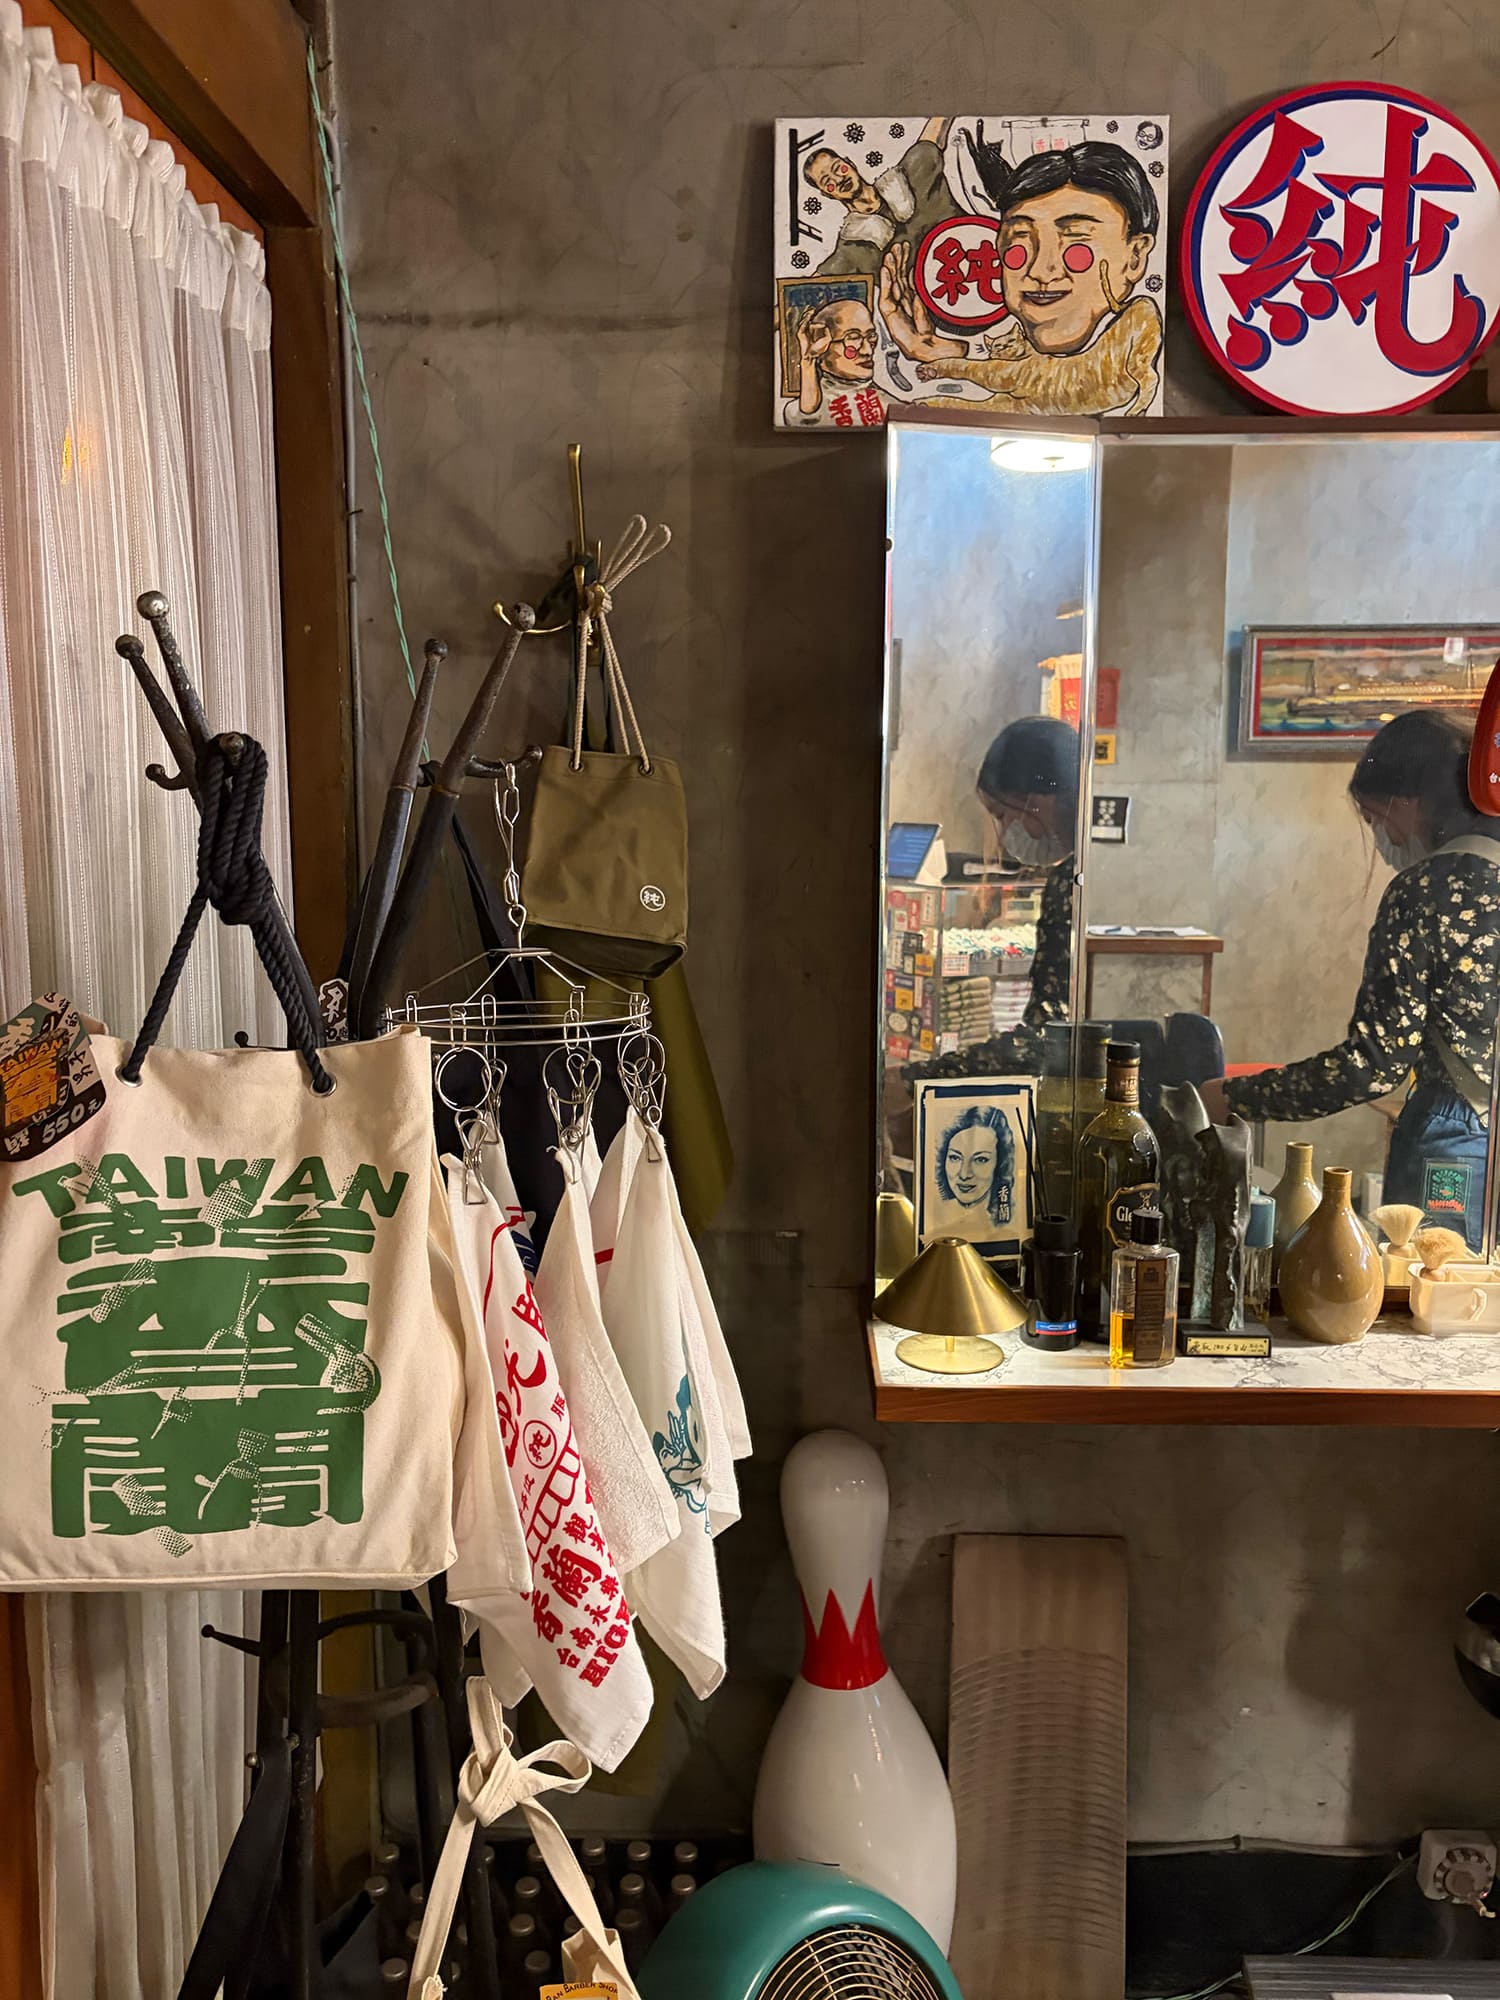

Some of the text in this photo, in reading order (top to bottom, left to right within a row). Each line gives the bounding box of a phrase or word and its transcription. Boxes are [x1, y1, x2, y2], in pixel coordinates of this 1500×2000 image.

[1219, 103, 1486, 377] 純
[829, 388, 885, 428] 香蘭
[12, 1153, 410, 1218] TAIWAN
[512, 1543, 602, 1643] 香蘭
